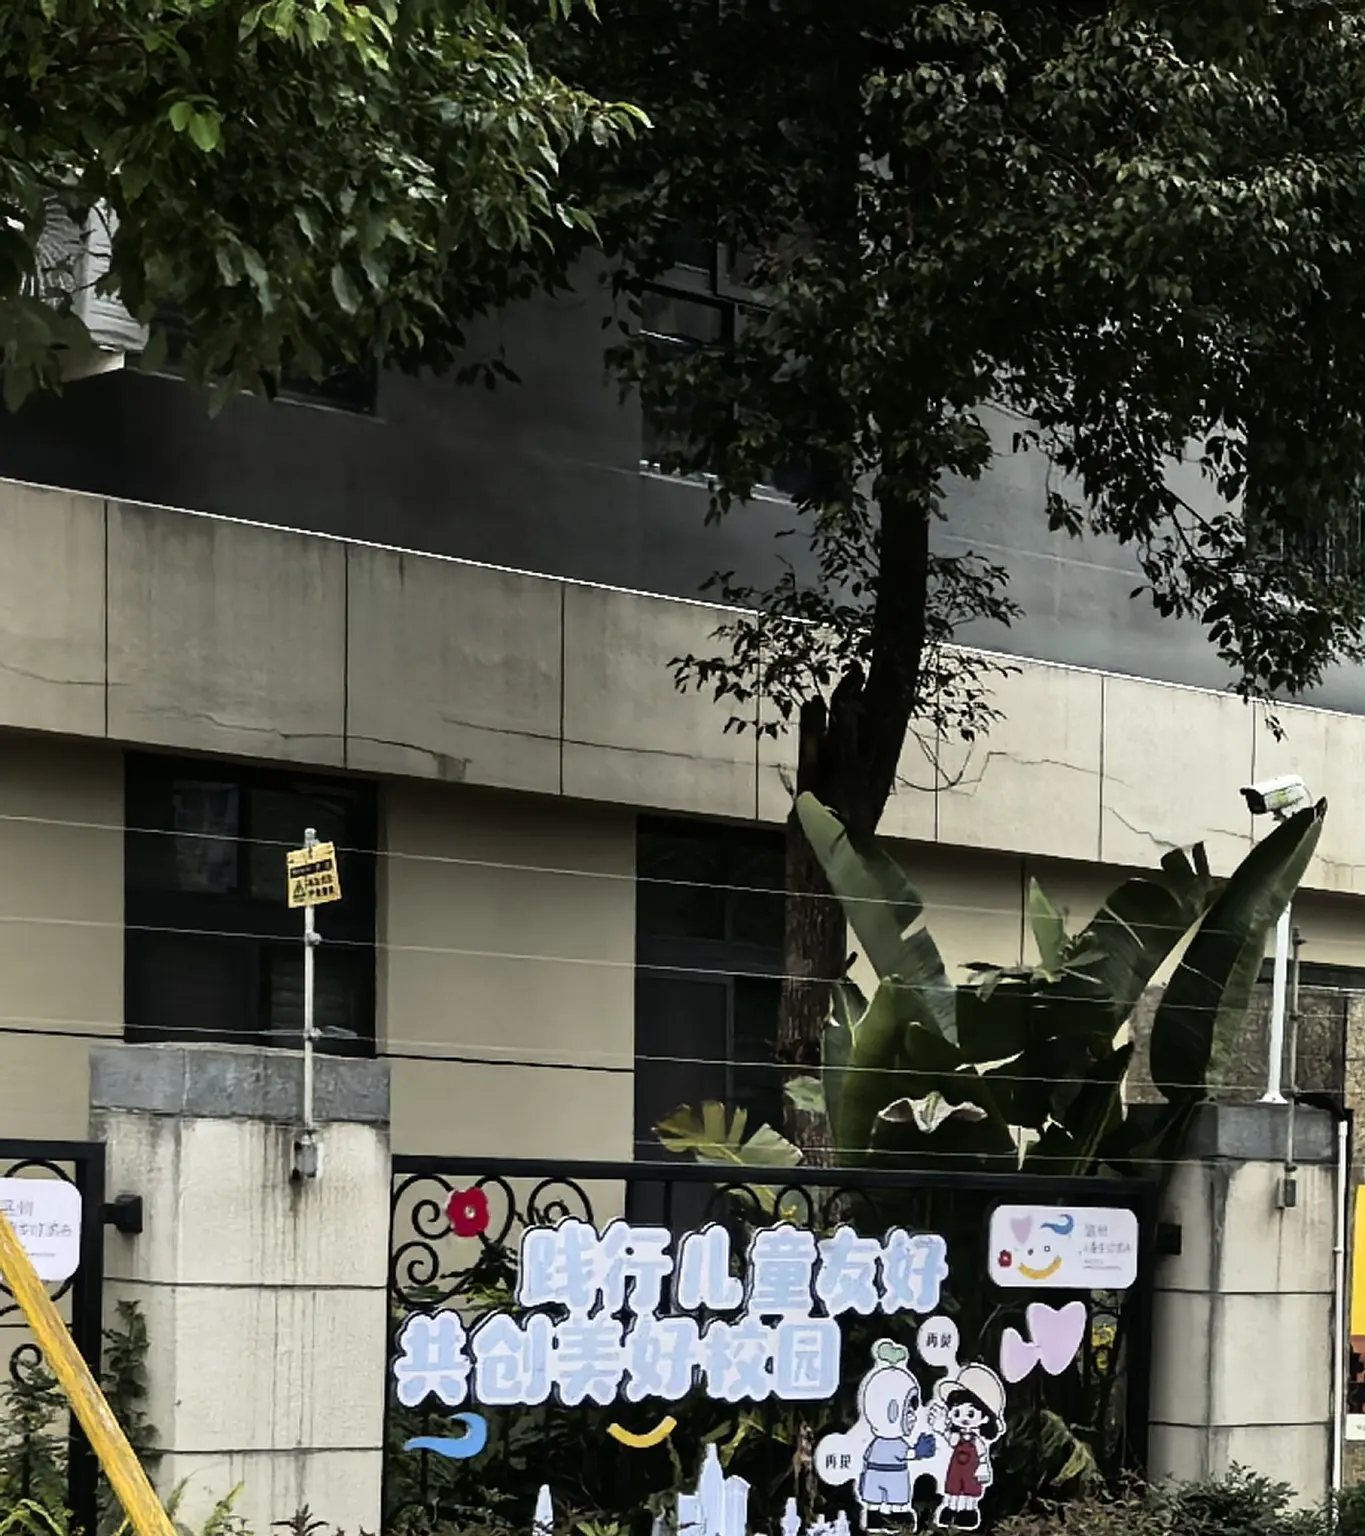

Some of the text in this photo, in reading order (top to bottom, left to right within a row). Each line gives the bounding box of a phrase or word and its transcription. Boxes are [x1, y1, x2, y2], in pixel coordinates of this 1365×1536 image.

[522, 1221, 947, 1313] 践行儿童友好
[398, 1314, 839, 1404] 共创美好校园
